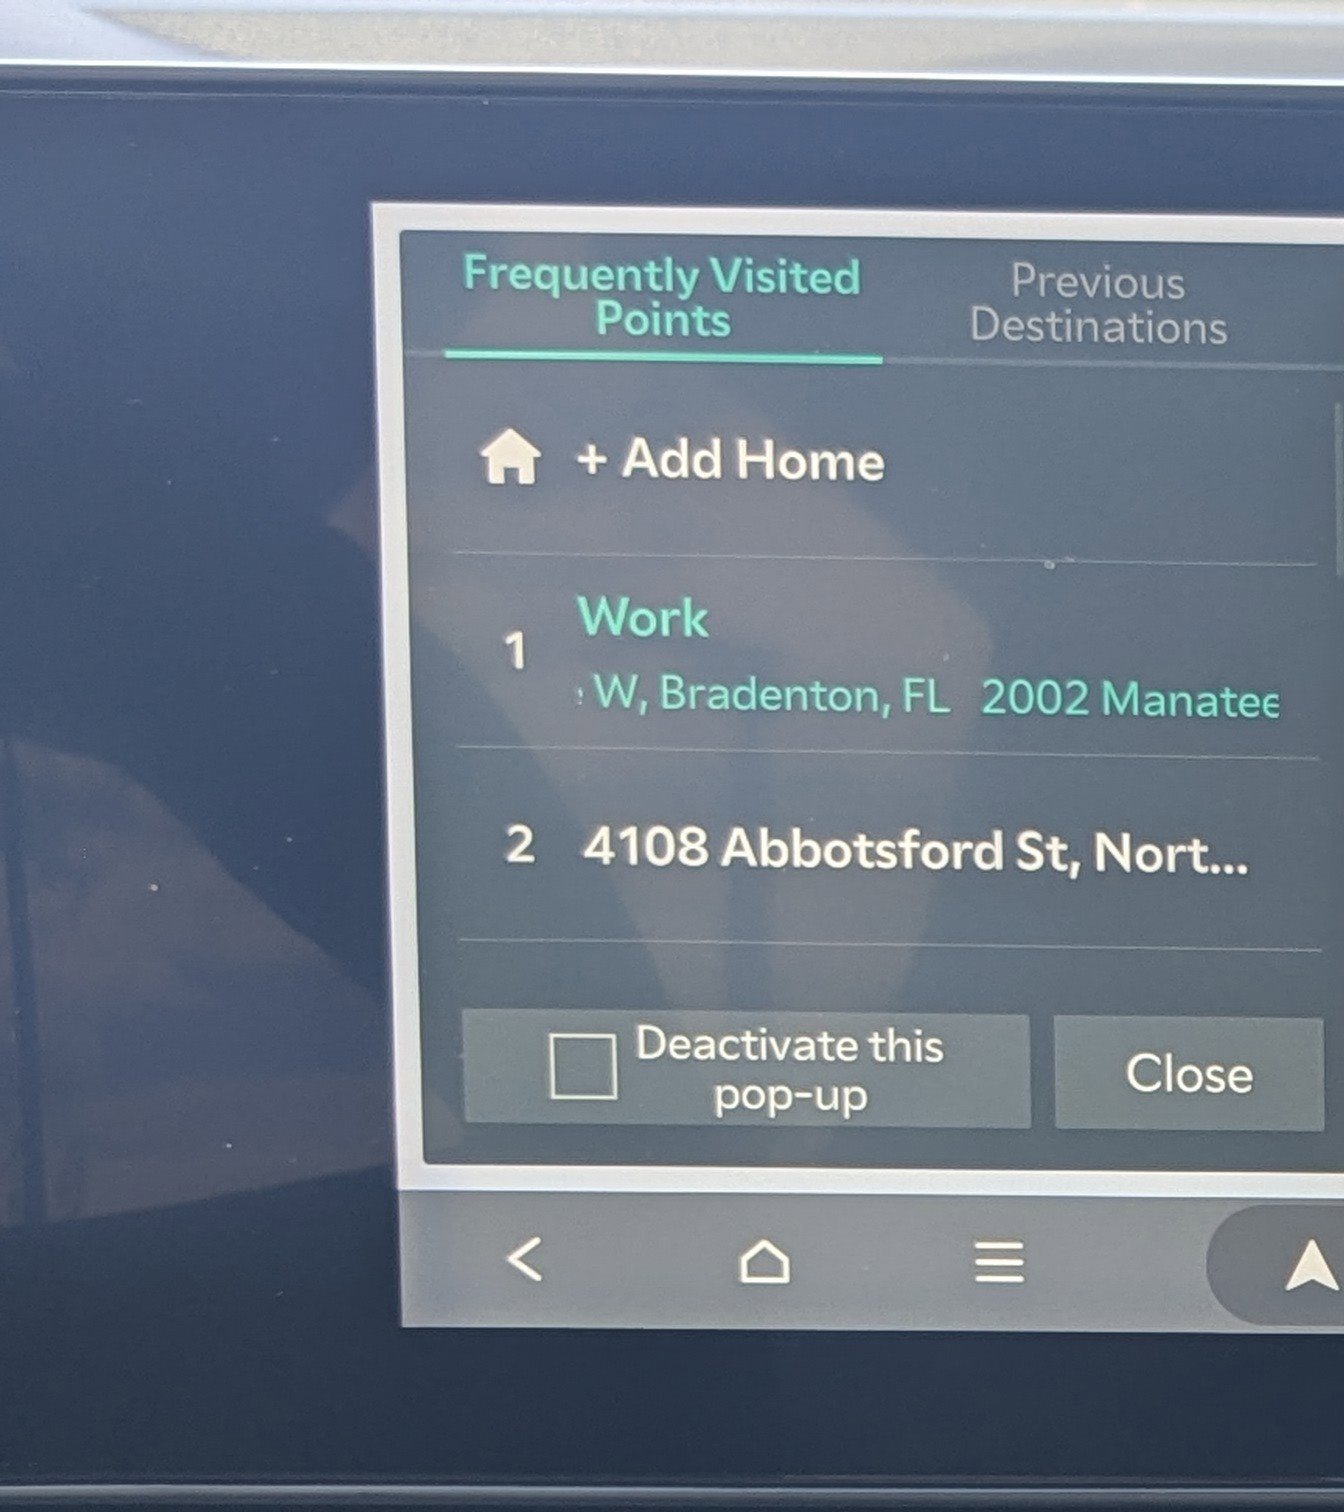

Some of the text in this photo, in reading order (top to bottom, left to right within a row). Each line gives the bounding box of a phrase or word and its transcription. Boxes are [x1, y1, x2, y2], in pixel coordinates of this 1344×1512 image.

[463, 253, 862, 297] Frequently Visited
[1010, 262, 1187, 301] Previous
[596, 300, 732, 337] Points
[970, 306, 1229, 348] Destinations
[622, 437, 725, 479] Add
[736, 438, 886, 482] Home
[577, 597, 710, 637] Work
[504, 631, 525, 670] 1
[660, 674, 893, 719] Bradenton,
[903, 678, 951, 715] FL
[981, 679, 1090, 717] 2002
[504, 824, 536, 864] 2
[582, 826, 710, 867] 4108
[720, 829, 1003, 874] Abbotsford
[1015, 834, 1082, 879] St,
[636, 1025, 945, 1065] Deactivate this
[1126, 1054, 1255, 1094] Close
[715, 1080, 868, 1118] pop-up
